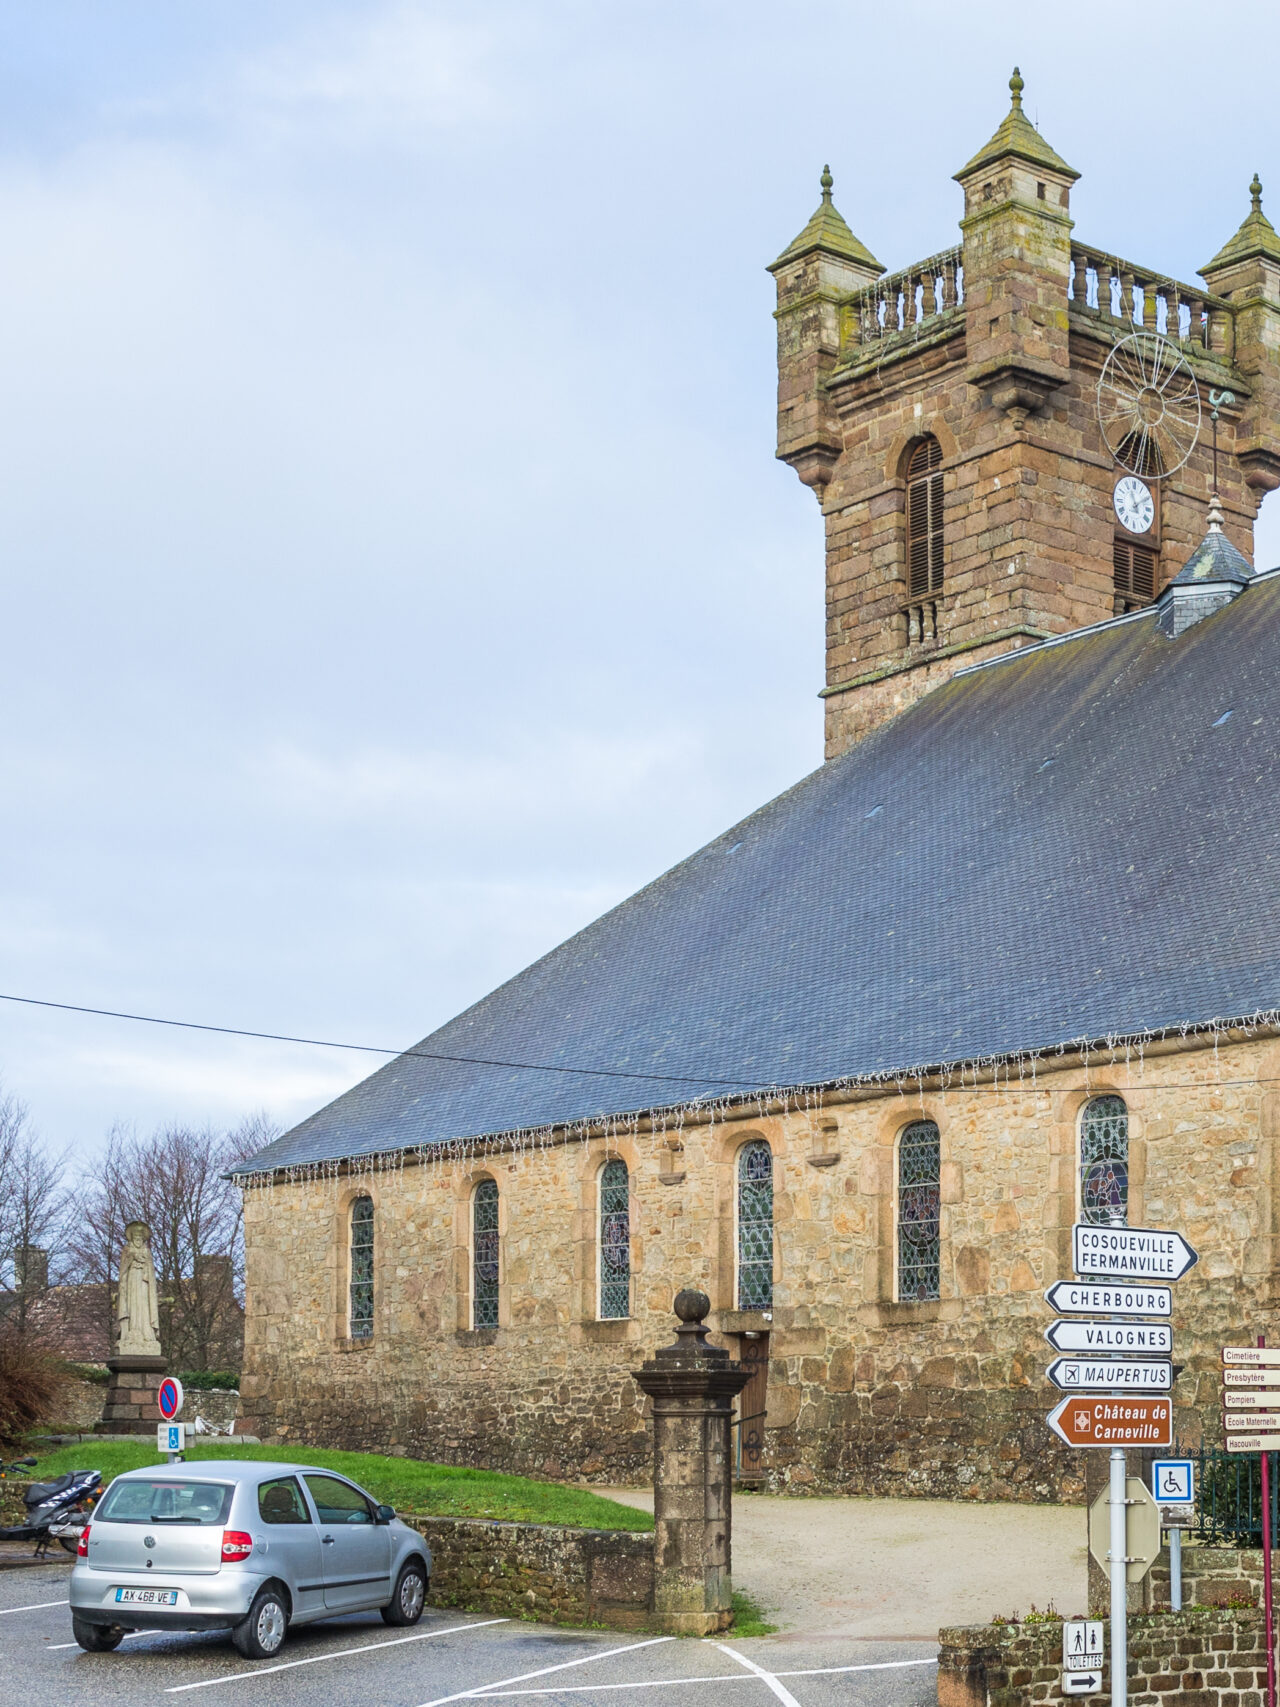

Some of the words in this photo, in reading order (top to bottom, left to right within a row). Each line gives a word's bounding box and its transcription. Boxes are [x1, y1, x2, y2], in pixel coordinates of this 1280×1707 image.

[1082, 1234, 1174, 1254] COSQUEVILLE
[1082, 1253, 1174, 1273] FERMANVILLE
[1070, 1291, 1167, 1309] CHERBOURG
[1086, 1329, 1167, 1345] VALOGNES
[1226, 1351, 1260, 1361] Cimetière
[1084, 1365, 1167, 1383] MAUPERTUS
[1226, 1373, 1265, 1384] Presbytère
[1227, 1395, 1256, 1405] Pompiers
[1094, 1404, 1147, 1420] Château
[1152, 1405, 1167, 1420] de
[1246, 1417, 1277, 1426] Maternelle
[1094, 1424, 1160, 1439] Carneville
[1229, 1438, 1261, 1448] Hacouville
[1071, 1656, 1101, 1668] TOILETTES
